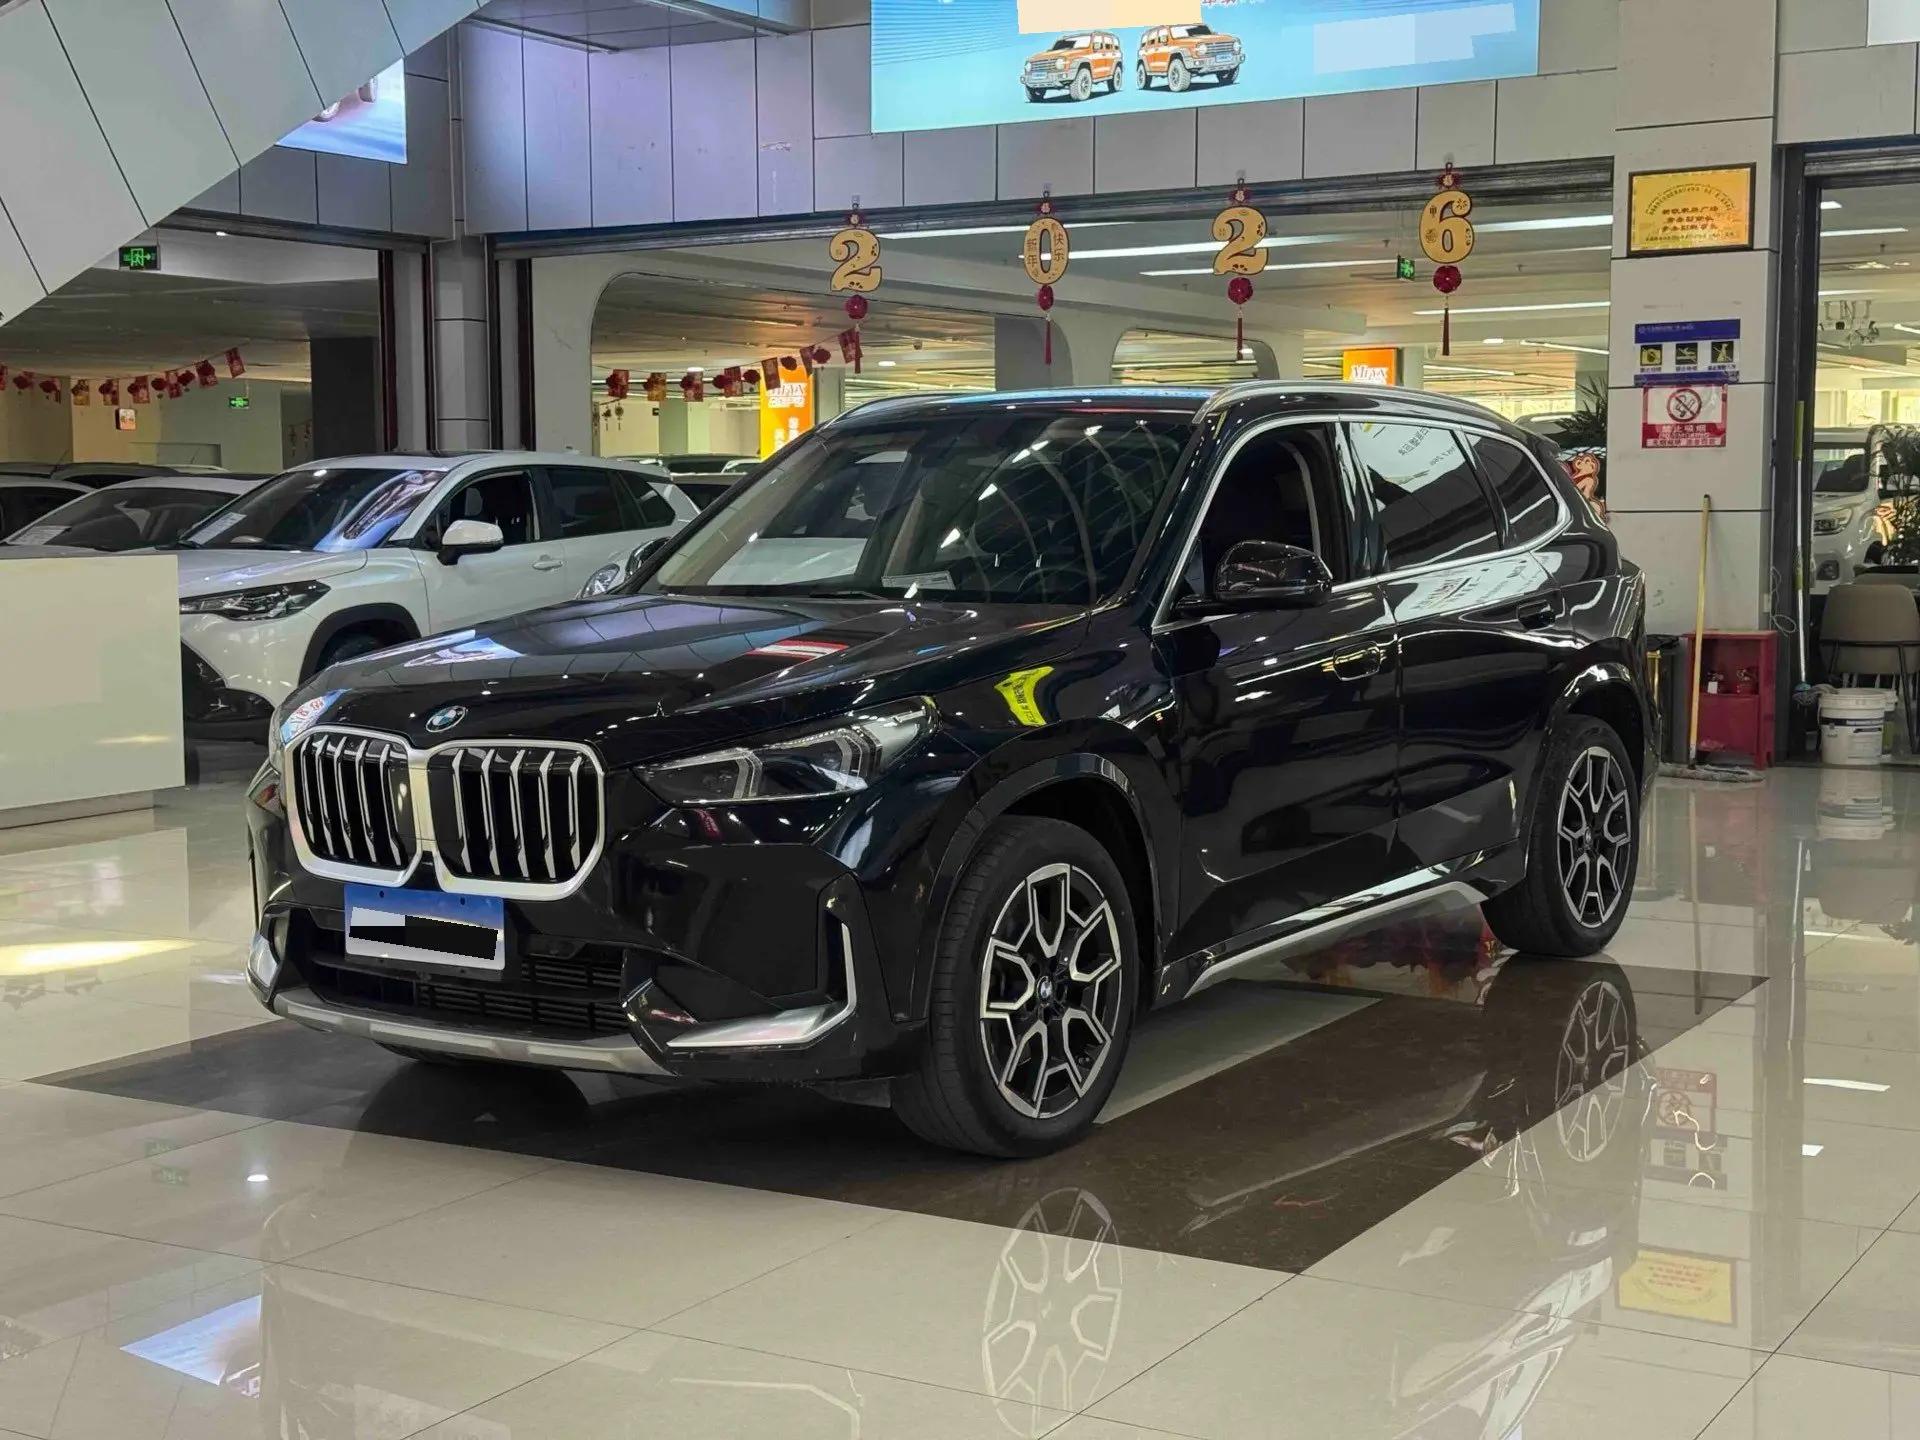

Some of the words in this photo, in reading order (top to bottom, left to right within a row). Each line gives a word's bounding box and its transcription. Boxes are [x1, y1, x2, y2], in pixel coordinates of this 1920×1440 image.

[829, 228, 882, 292] 2
[1212, 205, 1268, 275] 2
[1419, 190, 1474, 264] 6
[1053, 227, 1065, 261] 快乐
